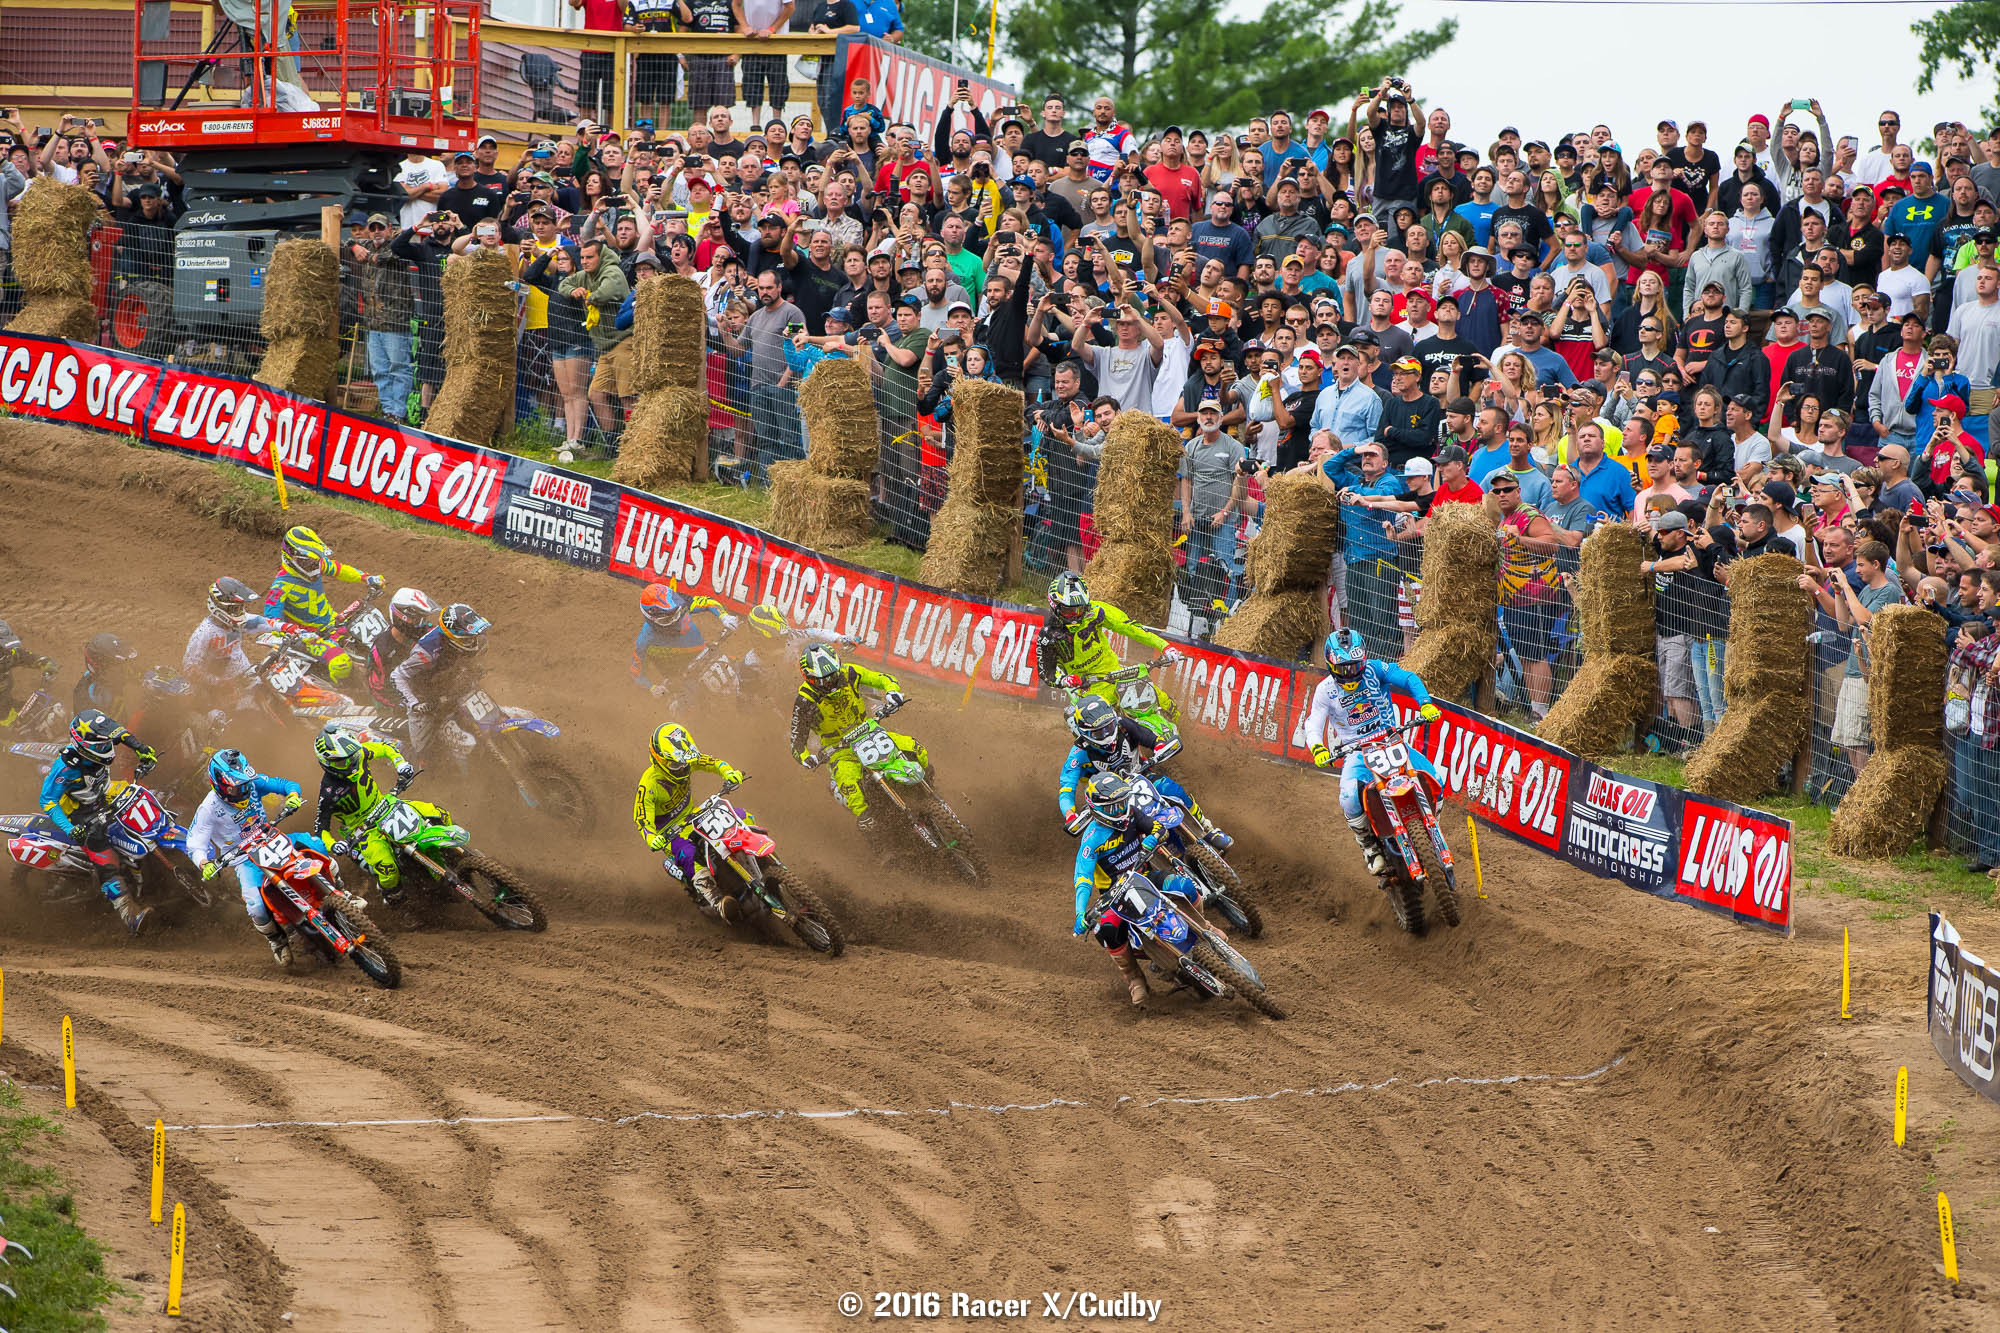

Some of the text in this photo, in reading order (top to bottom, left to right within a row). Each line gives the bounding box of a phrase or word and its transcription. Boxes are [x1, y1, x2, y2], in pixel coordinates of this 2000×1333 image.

[139, 119, 185, 134] SKYJACK
[188, 212, 227, 224] SKYJACK
[86, 364, 148, 425] OIL
[153, 381, 272, 455] LUCAS
[275, 407, 317, 472] OIL
[327, 425, 497, 524] LUCAS OIL
[532, 473, 589, 509] LUCAS OIL
[545, 504, 572, 518] PRO
[504, 531, 601, 565] CHAMPIONSHIP
[506, 506, 604, 554] MOTOCROSS
[614, 506, 753, 604] LUCAS OIL
[761, 555, 884, 649] LUCAS OIL
[893, 598, 993, 677] LUCAS
[991, 619, 1036, 686] OIL
[465, 690, 495, 720] 69
[1120, 682, 1156, 709] 44
[1238, 671, 1282, 742] OIL
[1356, 720, 1380, 735] KTM
[1367, 742, 1408, 776] 30
[1433, 720, 1564, 836] LUCAS OIL
[128, 794, 156, 831] 17
[1588, 775, 1652, 819] LUCAS OIL
[701, 804, 736, 840] 58
[1597, 812, 1625, 830] PRO
[19, 845, 46, 865] 17
[118, 840, 138, 853] YAMAHA
[258, 834, 293, 868] 42
[1567, 816, 1668, 873] MOTOCROSS
[1567, 845, 1664, 886] CHAMPIONSHIP
[1681, 815, 1789, 912] LUCAS OIL
[1124, 885, 1147, 915] 1
[1185, 965, 1217, 988] DUNLOP
